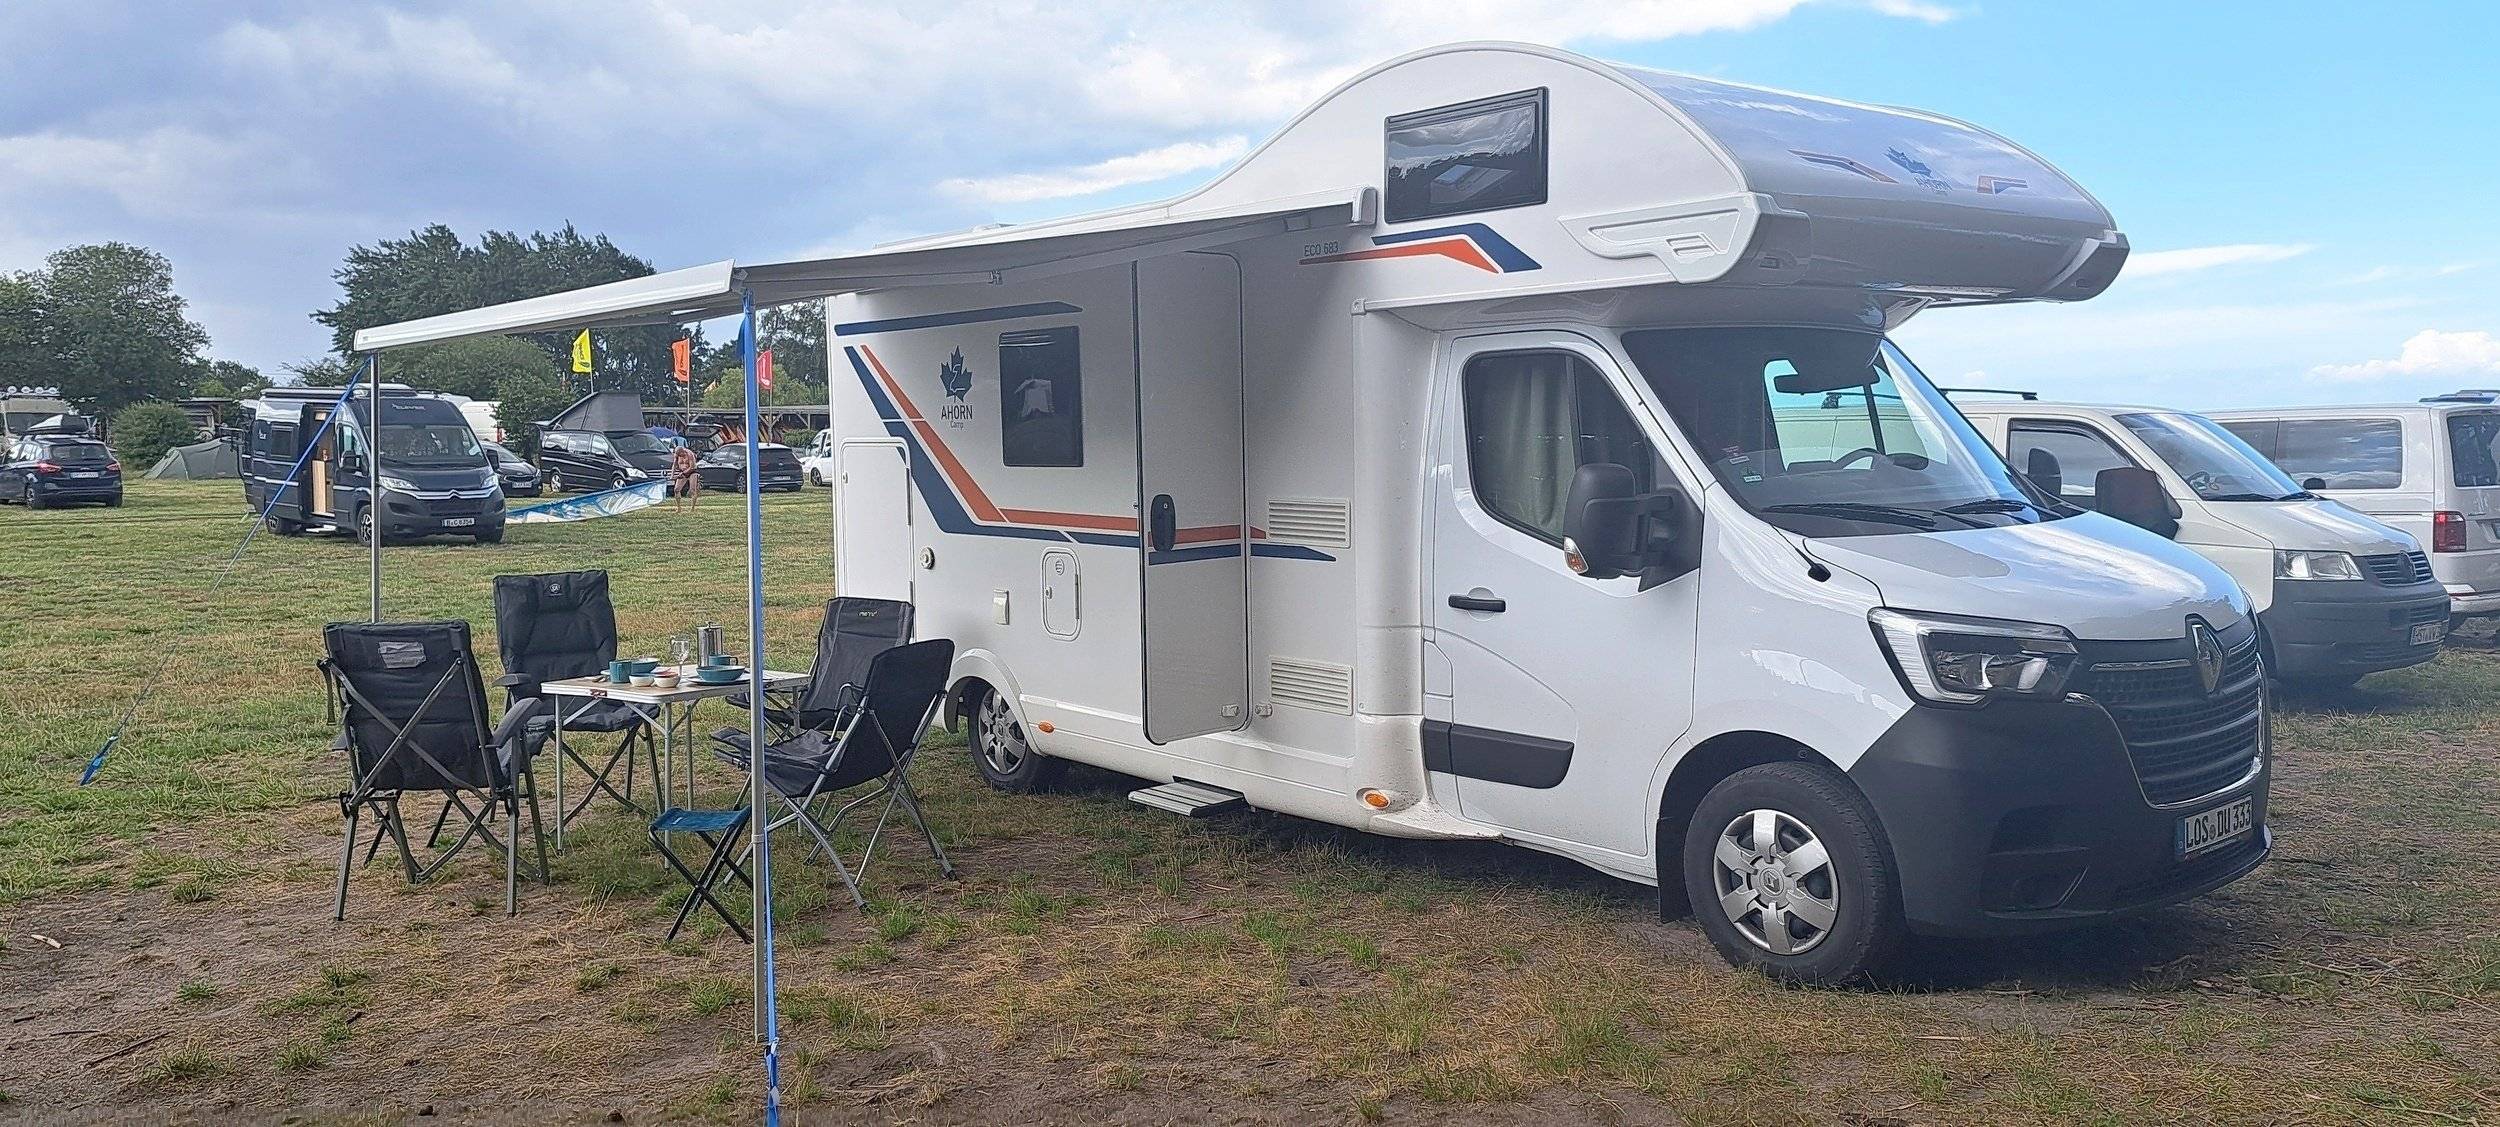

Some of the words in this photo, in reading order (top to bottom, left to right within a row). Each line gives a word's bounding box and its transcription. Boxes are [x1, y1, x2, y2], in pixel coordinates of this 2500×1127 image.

[1304, 243, 1321, 257] ECO
[1323, 241, 1339, 255] 683
[941, 404, 973, 420] AHORN
[950, 420, 964, 430] Camp
[2186, 815, 2209, 849] LOS
[2216, 807, 2231, 838] DU
[2232, 800, 2251, 831] 333
